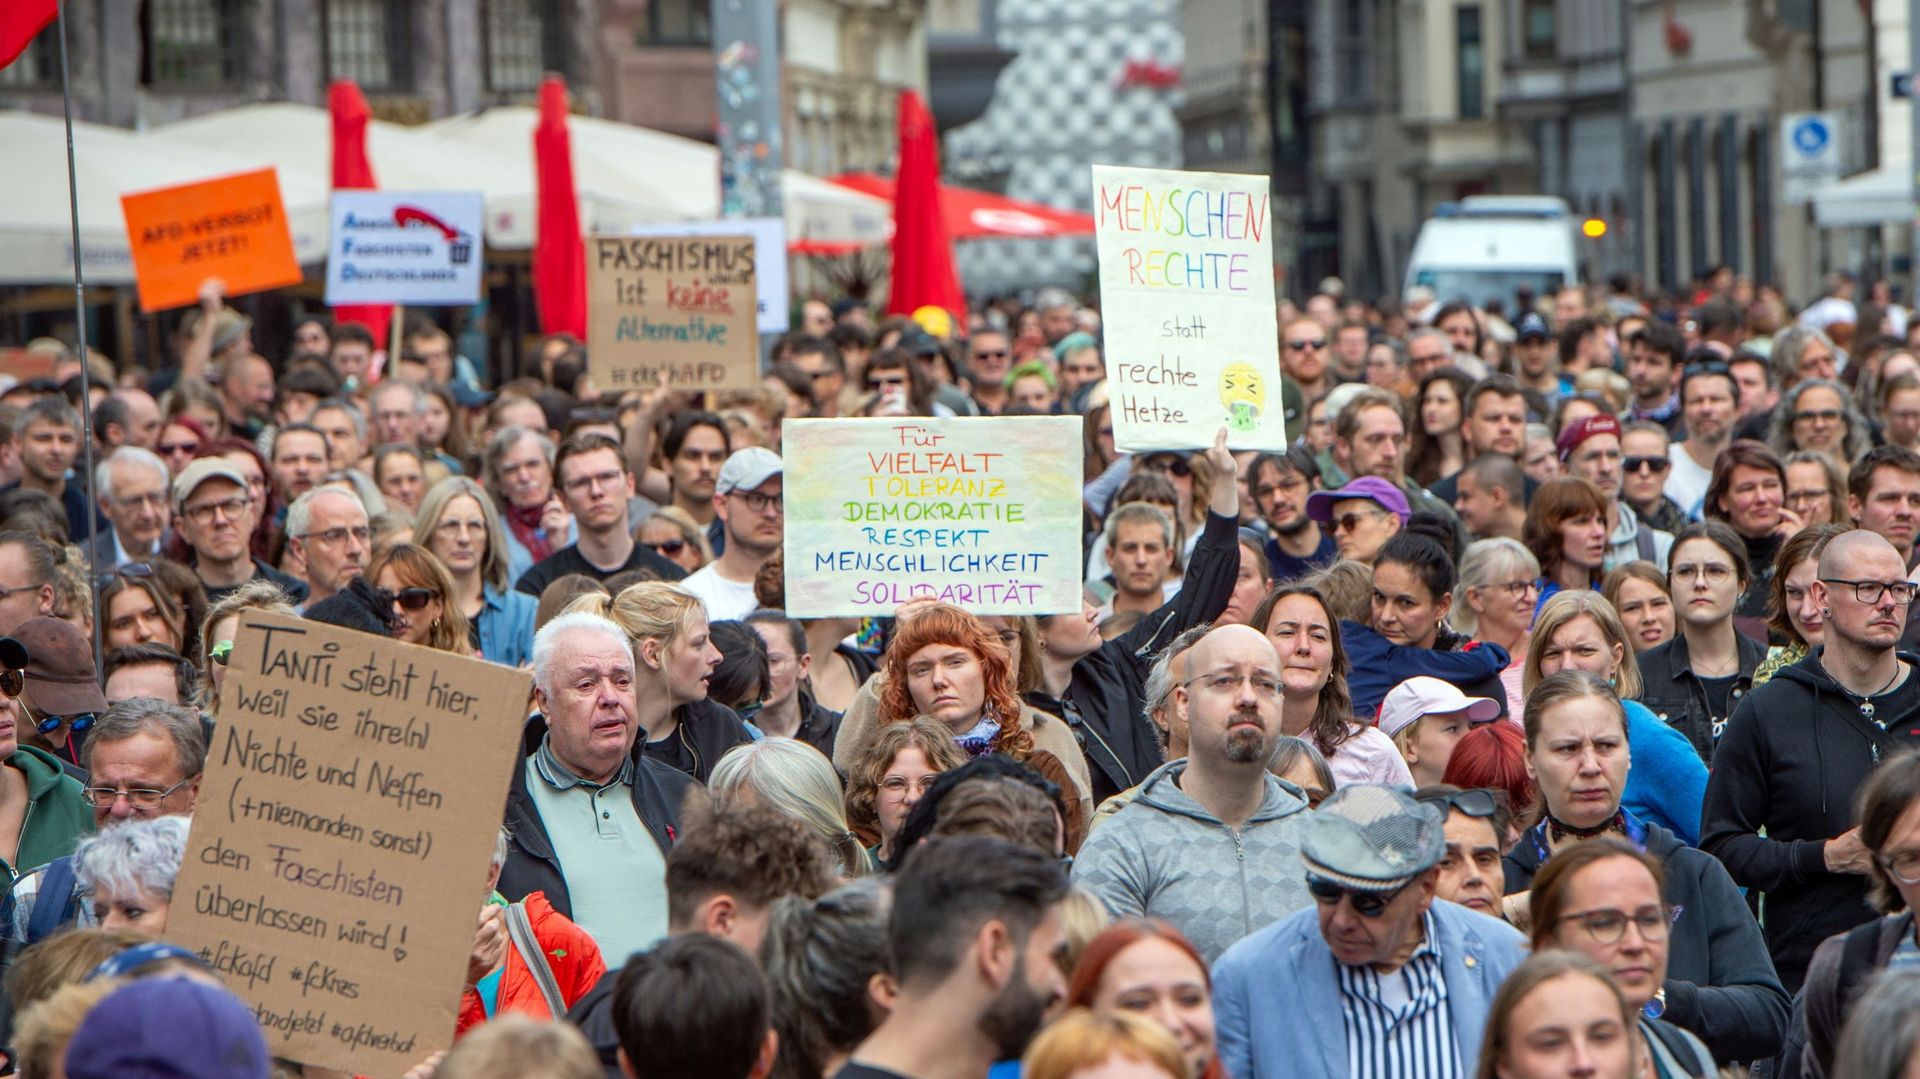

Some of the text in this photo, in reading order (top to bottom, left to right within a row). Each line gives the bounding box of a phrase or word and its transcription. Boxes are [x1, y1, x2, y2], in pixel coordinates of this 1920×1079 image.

[1100, 184, 1268, 243] MENSCHEN
[597, 238, 755, 274] FASCHISMUS
[1122, 247, 1250, 291] RECHTE
[665, 278, 731, 310] keine
[1161, 315, 1207, 339] statt
[1118, 353, 1199, 387] rechte
[1121, 393, 1189, 424] Hetze
[892, 425, 946, 448] Für
[867, 452, 1004, 475] VIELFALT
[859, 476, 1009, 498] TOLERANZ
[842, 500, 1026, 523] DEMOKRATIE
[861, 527, 990, 548] RESPEKT
[814, 551, 1049, 573] MENSCHLICHKEIT
[850, 579, 1044, 605] SOLIDARITÄT
[341, 651, 420, 701] steht
[296, 703, 340, 732] sie
[353, 708, 431, 750] ihre(n)
[221, 725, 443, 812] Nichte und Neffen
[368, 829, 433, 861] sonst)
[200, 837, 404, 907] den Faschisten
[194, 883, 329, 940] überlassen
